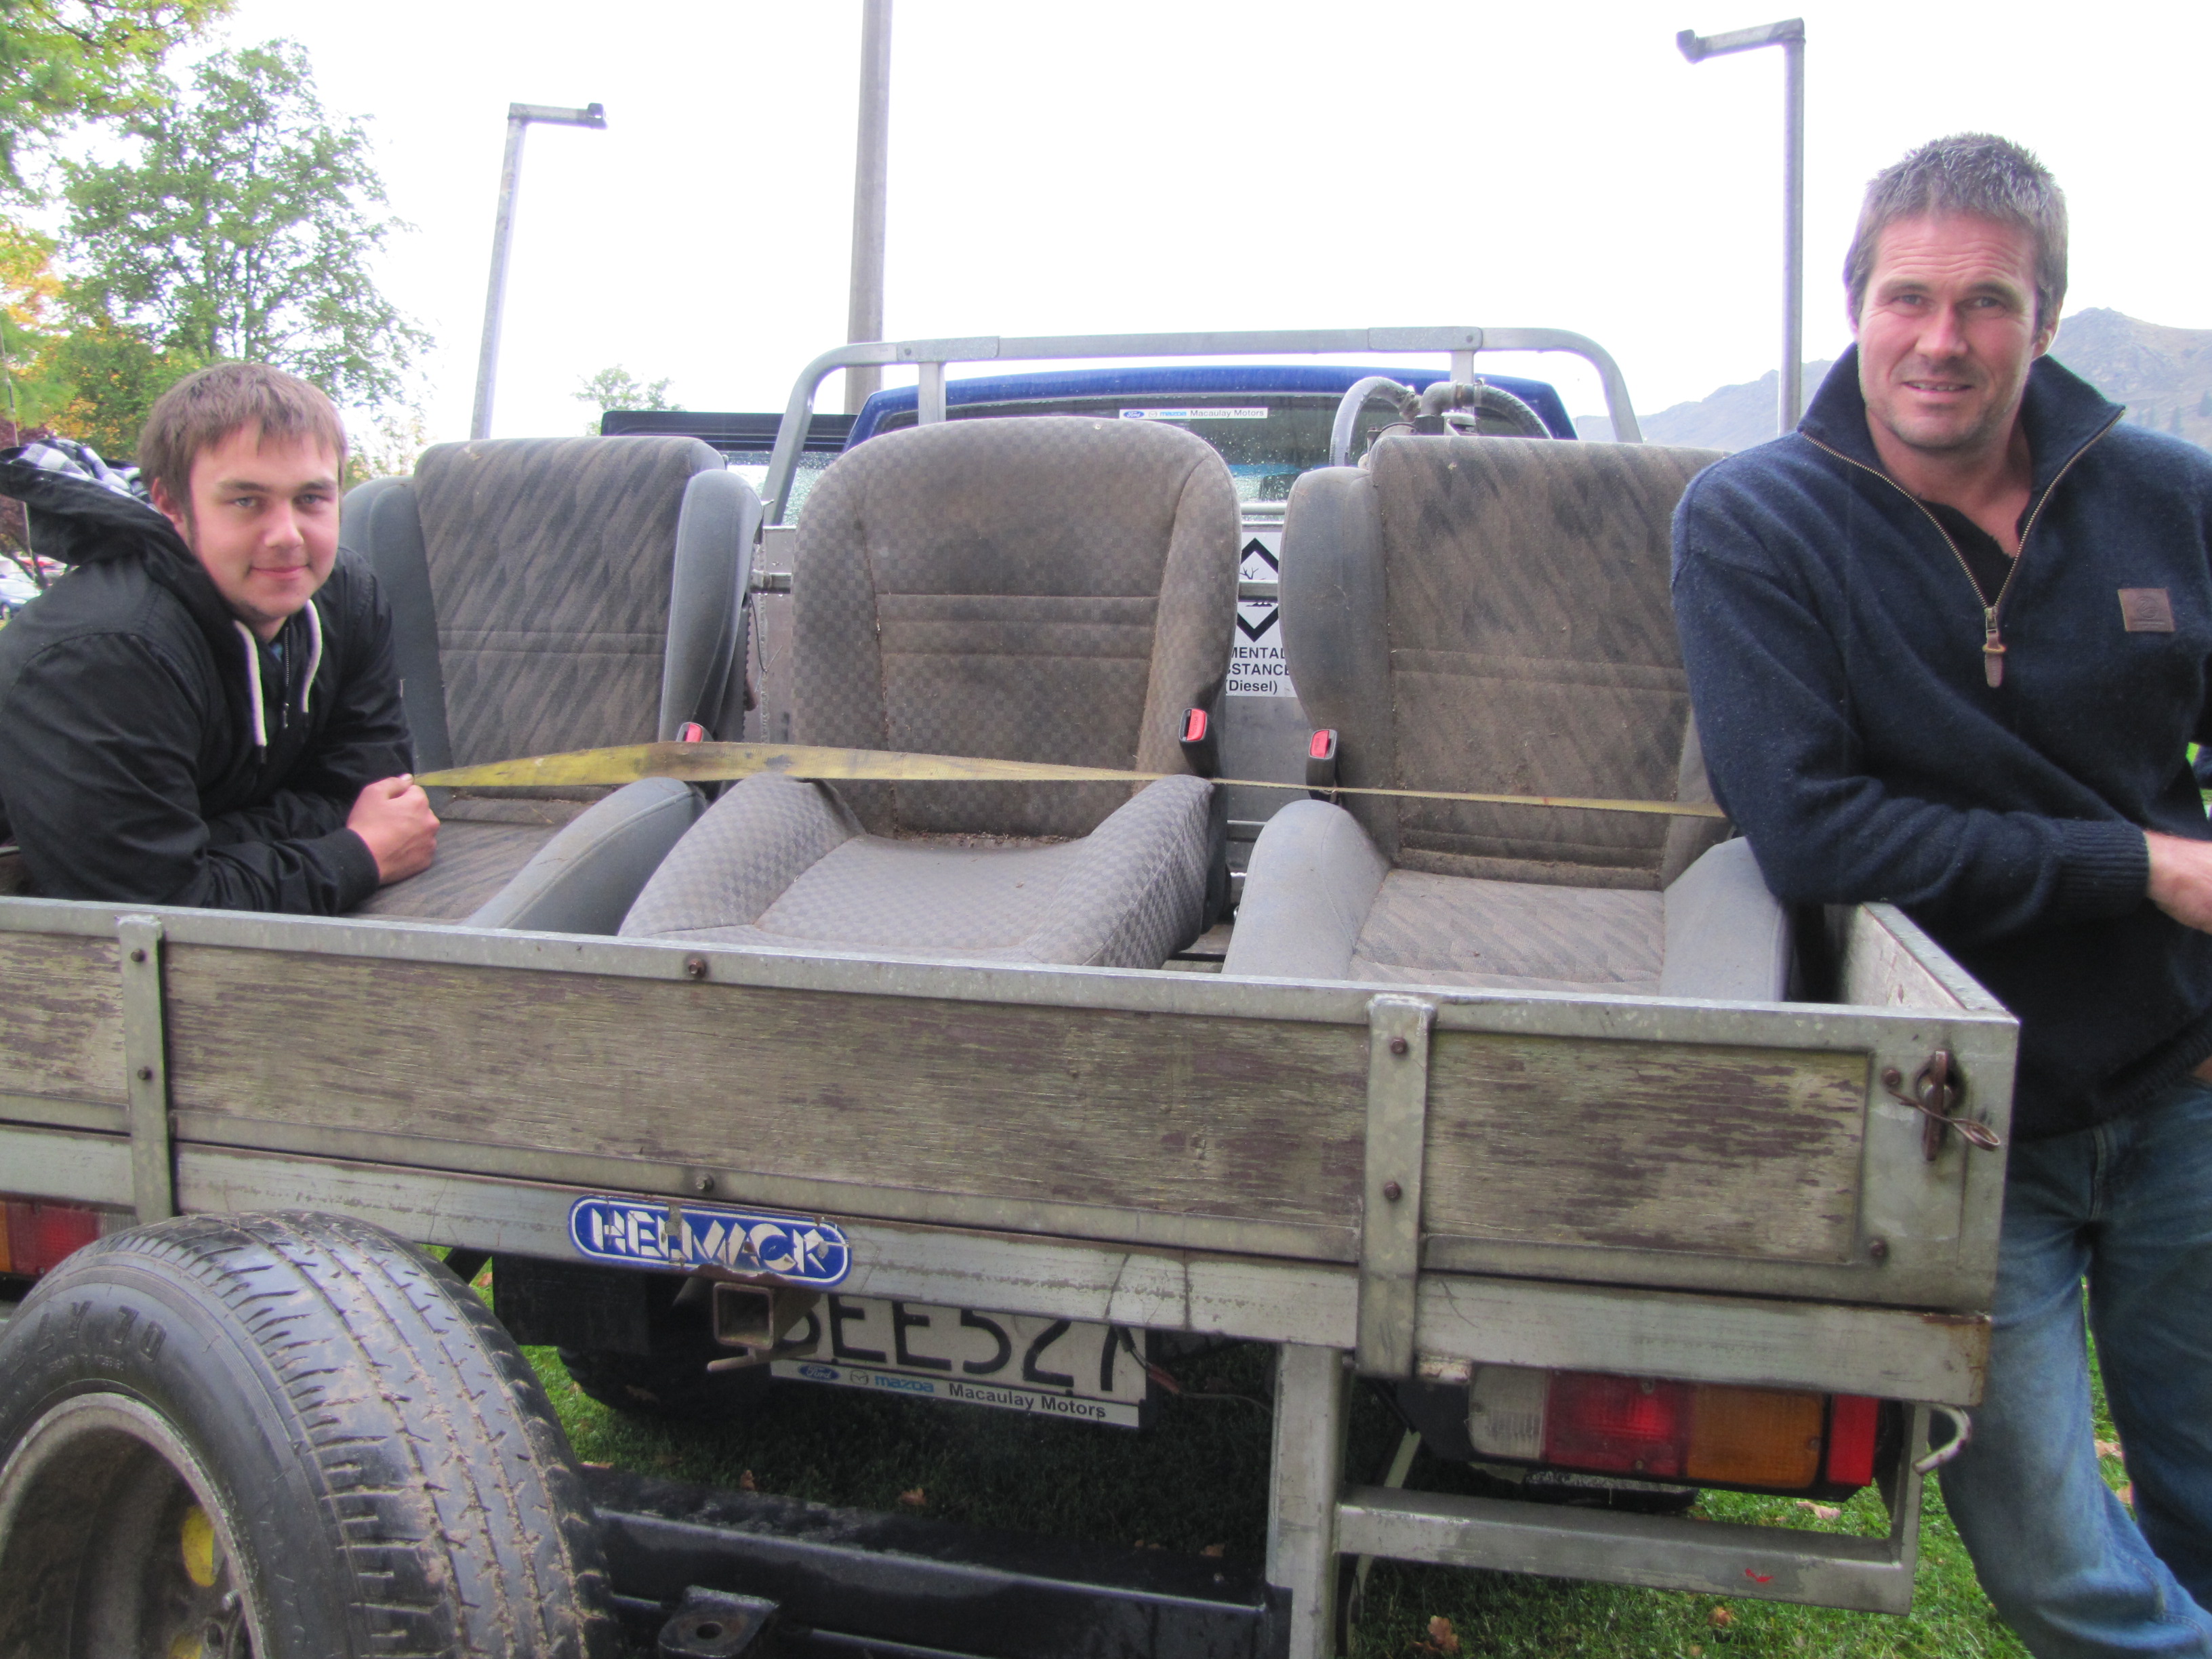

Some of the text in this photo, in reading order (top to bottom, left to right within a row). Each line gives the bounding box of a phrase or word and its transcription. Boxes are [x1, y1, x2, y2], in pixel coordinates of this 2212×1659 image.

[1191, 409, 1231, 418] Macaulay
[1234, 409, 1265, 417] Motors
[591, 1208, 827, 1274] HELMACK
[874, 1375, 935, 1393] mazda
[949, 1382, 1034, 1410] Macaulay
[1041, 1396, 1107, 1418] Motors
